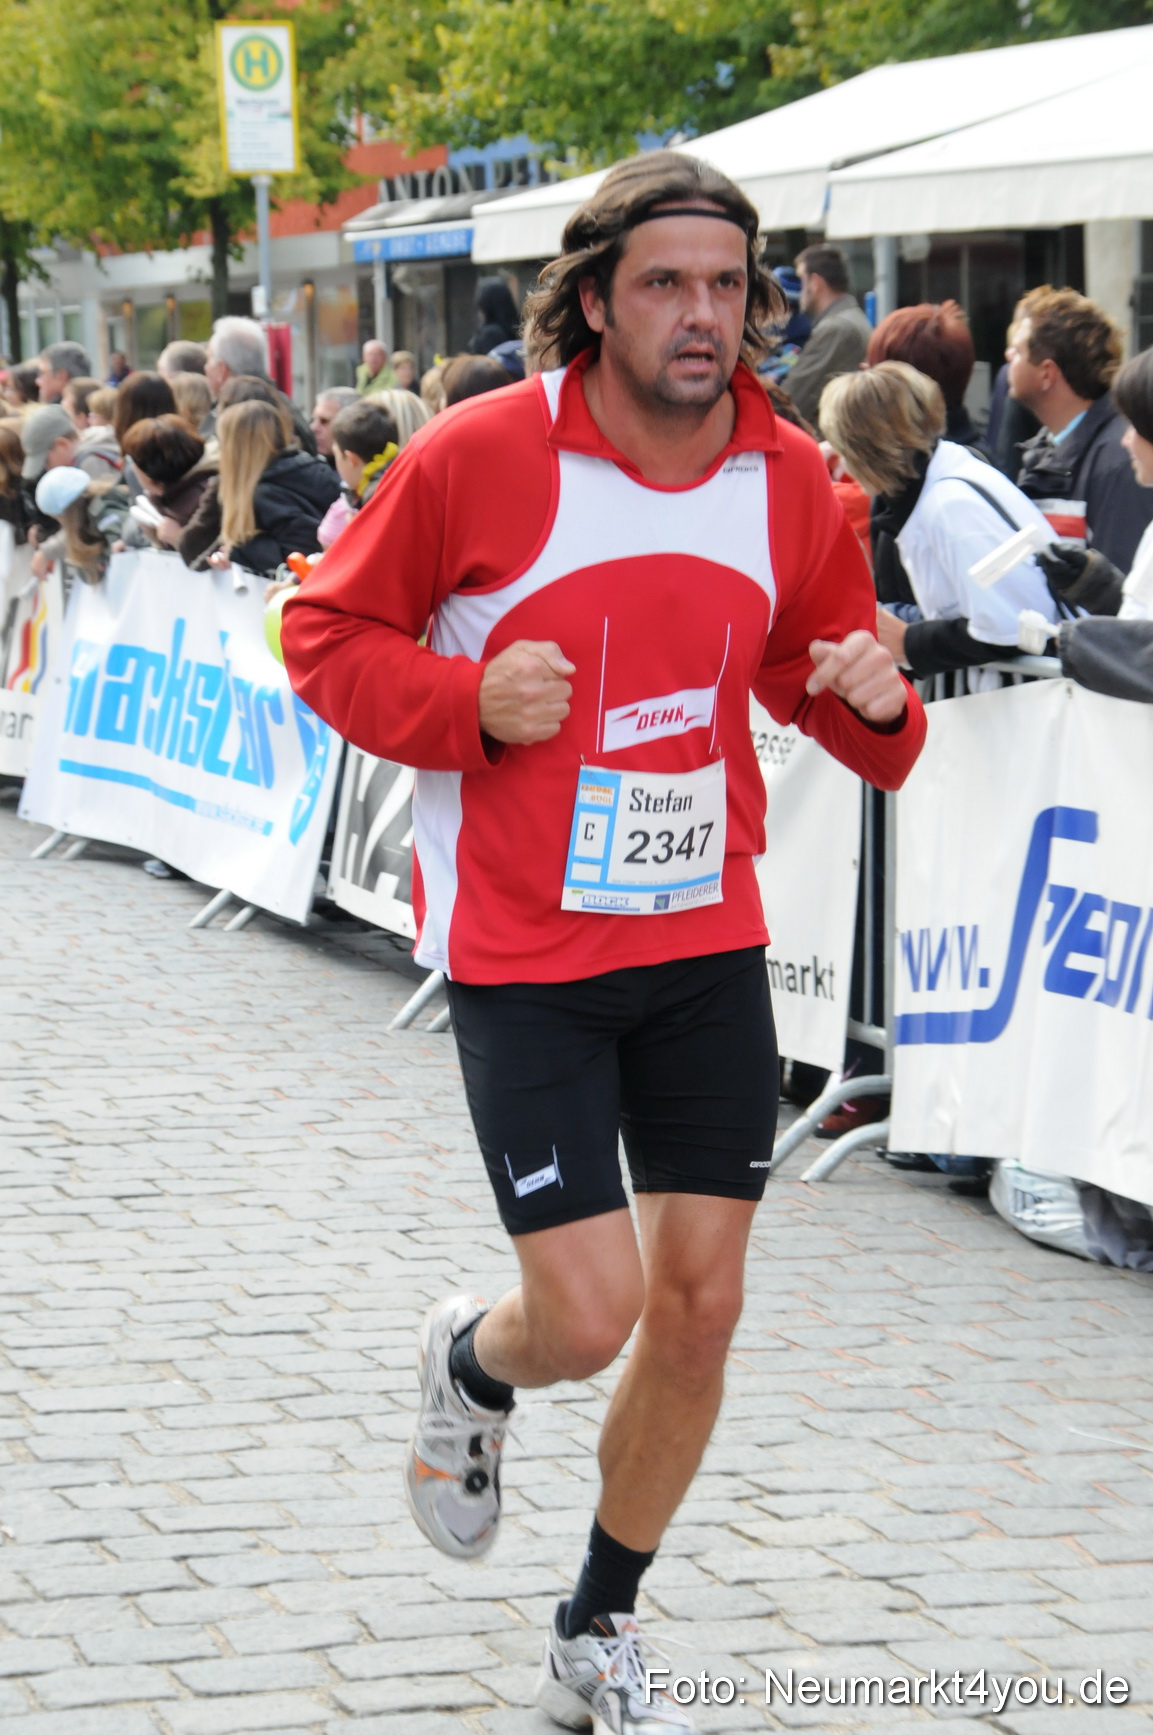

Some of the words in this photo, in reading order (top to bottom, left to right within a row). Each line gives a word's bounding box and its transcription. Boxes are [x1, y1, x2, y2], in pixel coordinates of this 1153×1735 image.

[244, 48, 269, 78] H
[378, 164, 477, 202] ANTON
[635, 704, 685, 732] DEHN
[629, 787, 693, 814] Stefan
[584, 821, 596, 841] C
[623, 821, 715, 865] 2347
[671, 882, 719, 903] PFLEIDERER
